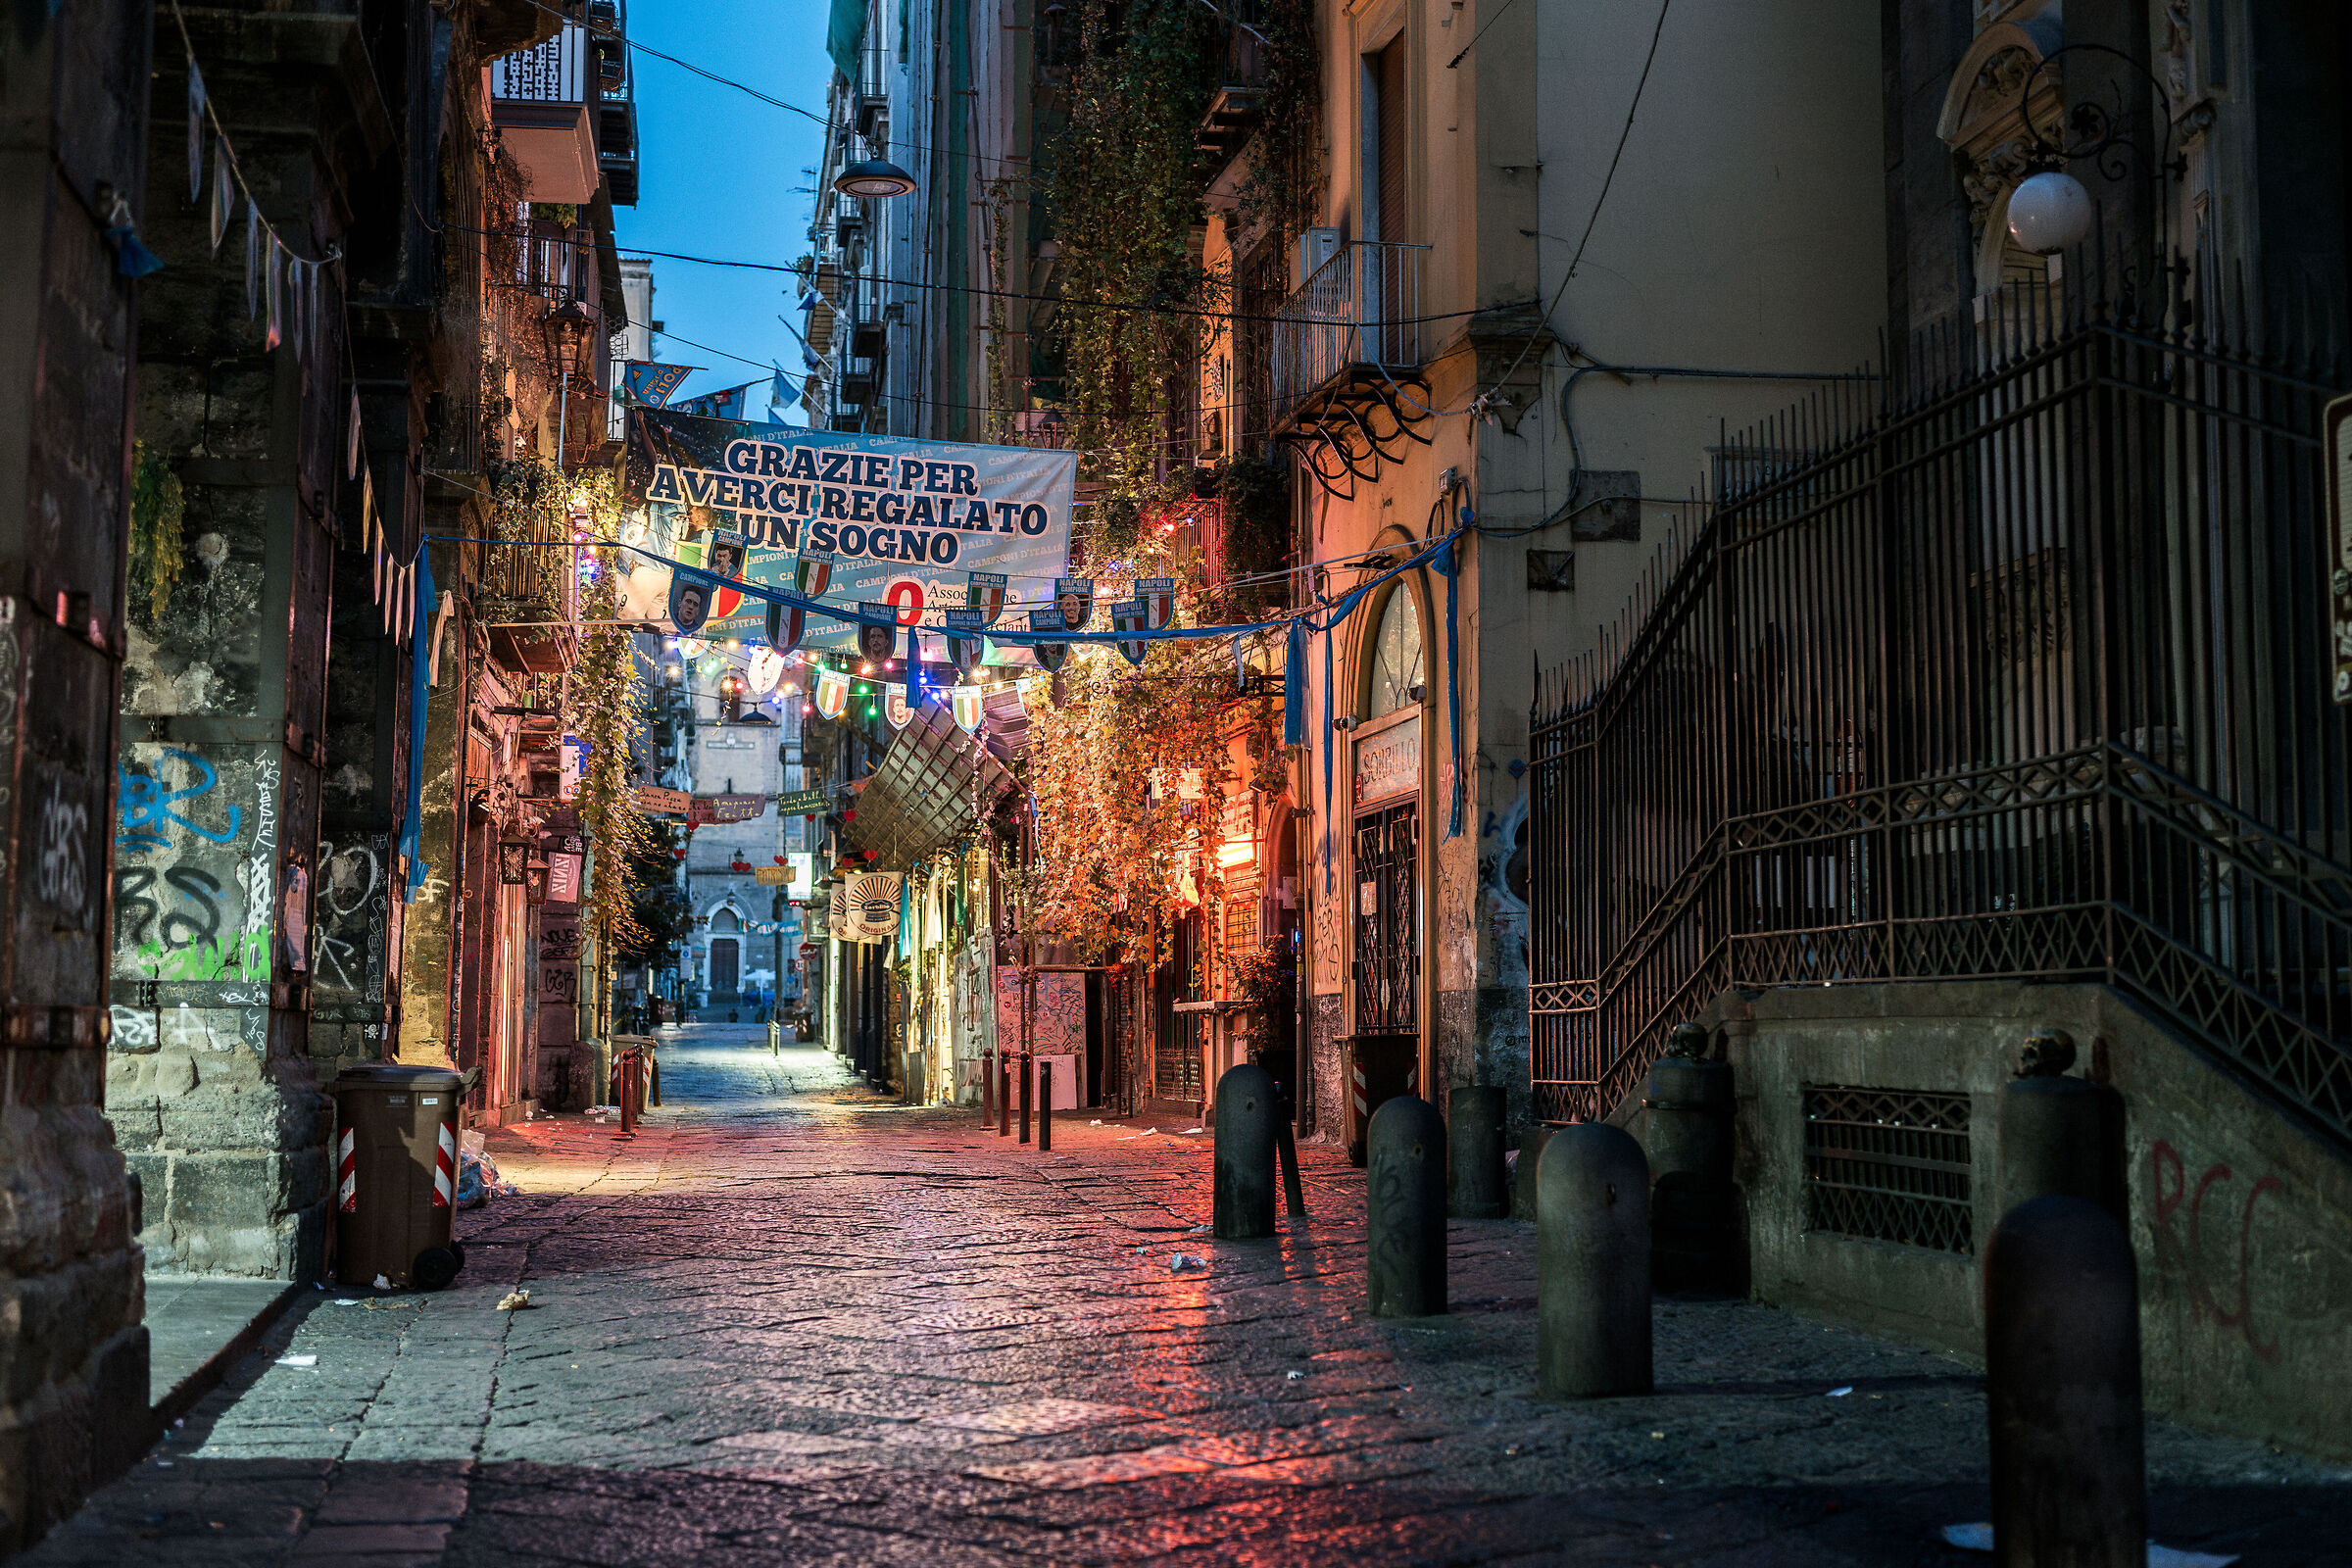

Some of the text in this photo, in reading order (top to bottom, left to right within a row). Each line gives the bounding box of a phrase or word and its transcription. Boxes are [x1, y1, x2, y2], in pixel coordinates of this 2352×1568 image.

[728, 441, 979, 496] GRAZIE PER
[651, 466, 1048, 536] AVERCI REGALATO
[739, 513, 958, 564] UN SOGNO
[802, 548, 832, 560] NAPOLI
[1020, 543, 1065, 560] D'ITALIA
[836, 560, 882, 572] D'ITALIA
[973, 572, 1004, 584] NAPOLI
[1058, 578, 1090, 588] NAPOLI
[862, 603, 894, 615] NAPOLI
[1115, 601, 1143, 612] NAPOLI
[950, 611, 980, 621] NAPOLI
[1033, 610, 1061, 619] NAPOLI
[1035, 617, 1061, 627] CAMPIONE
[806, 622, 853, 637] D'ITALIA
